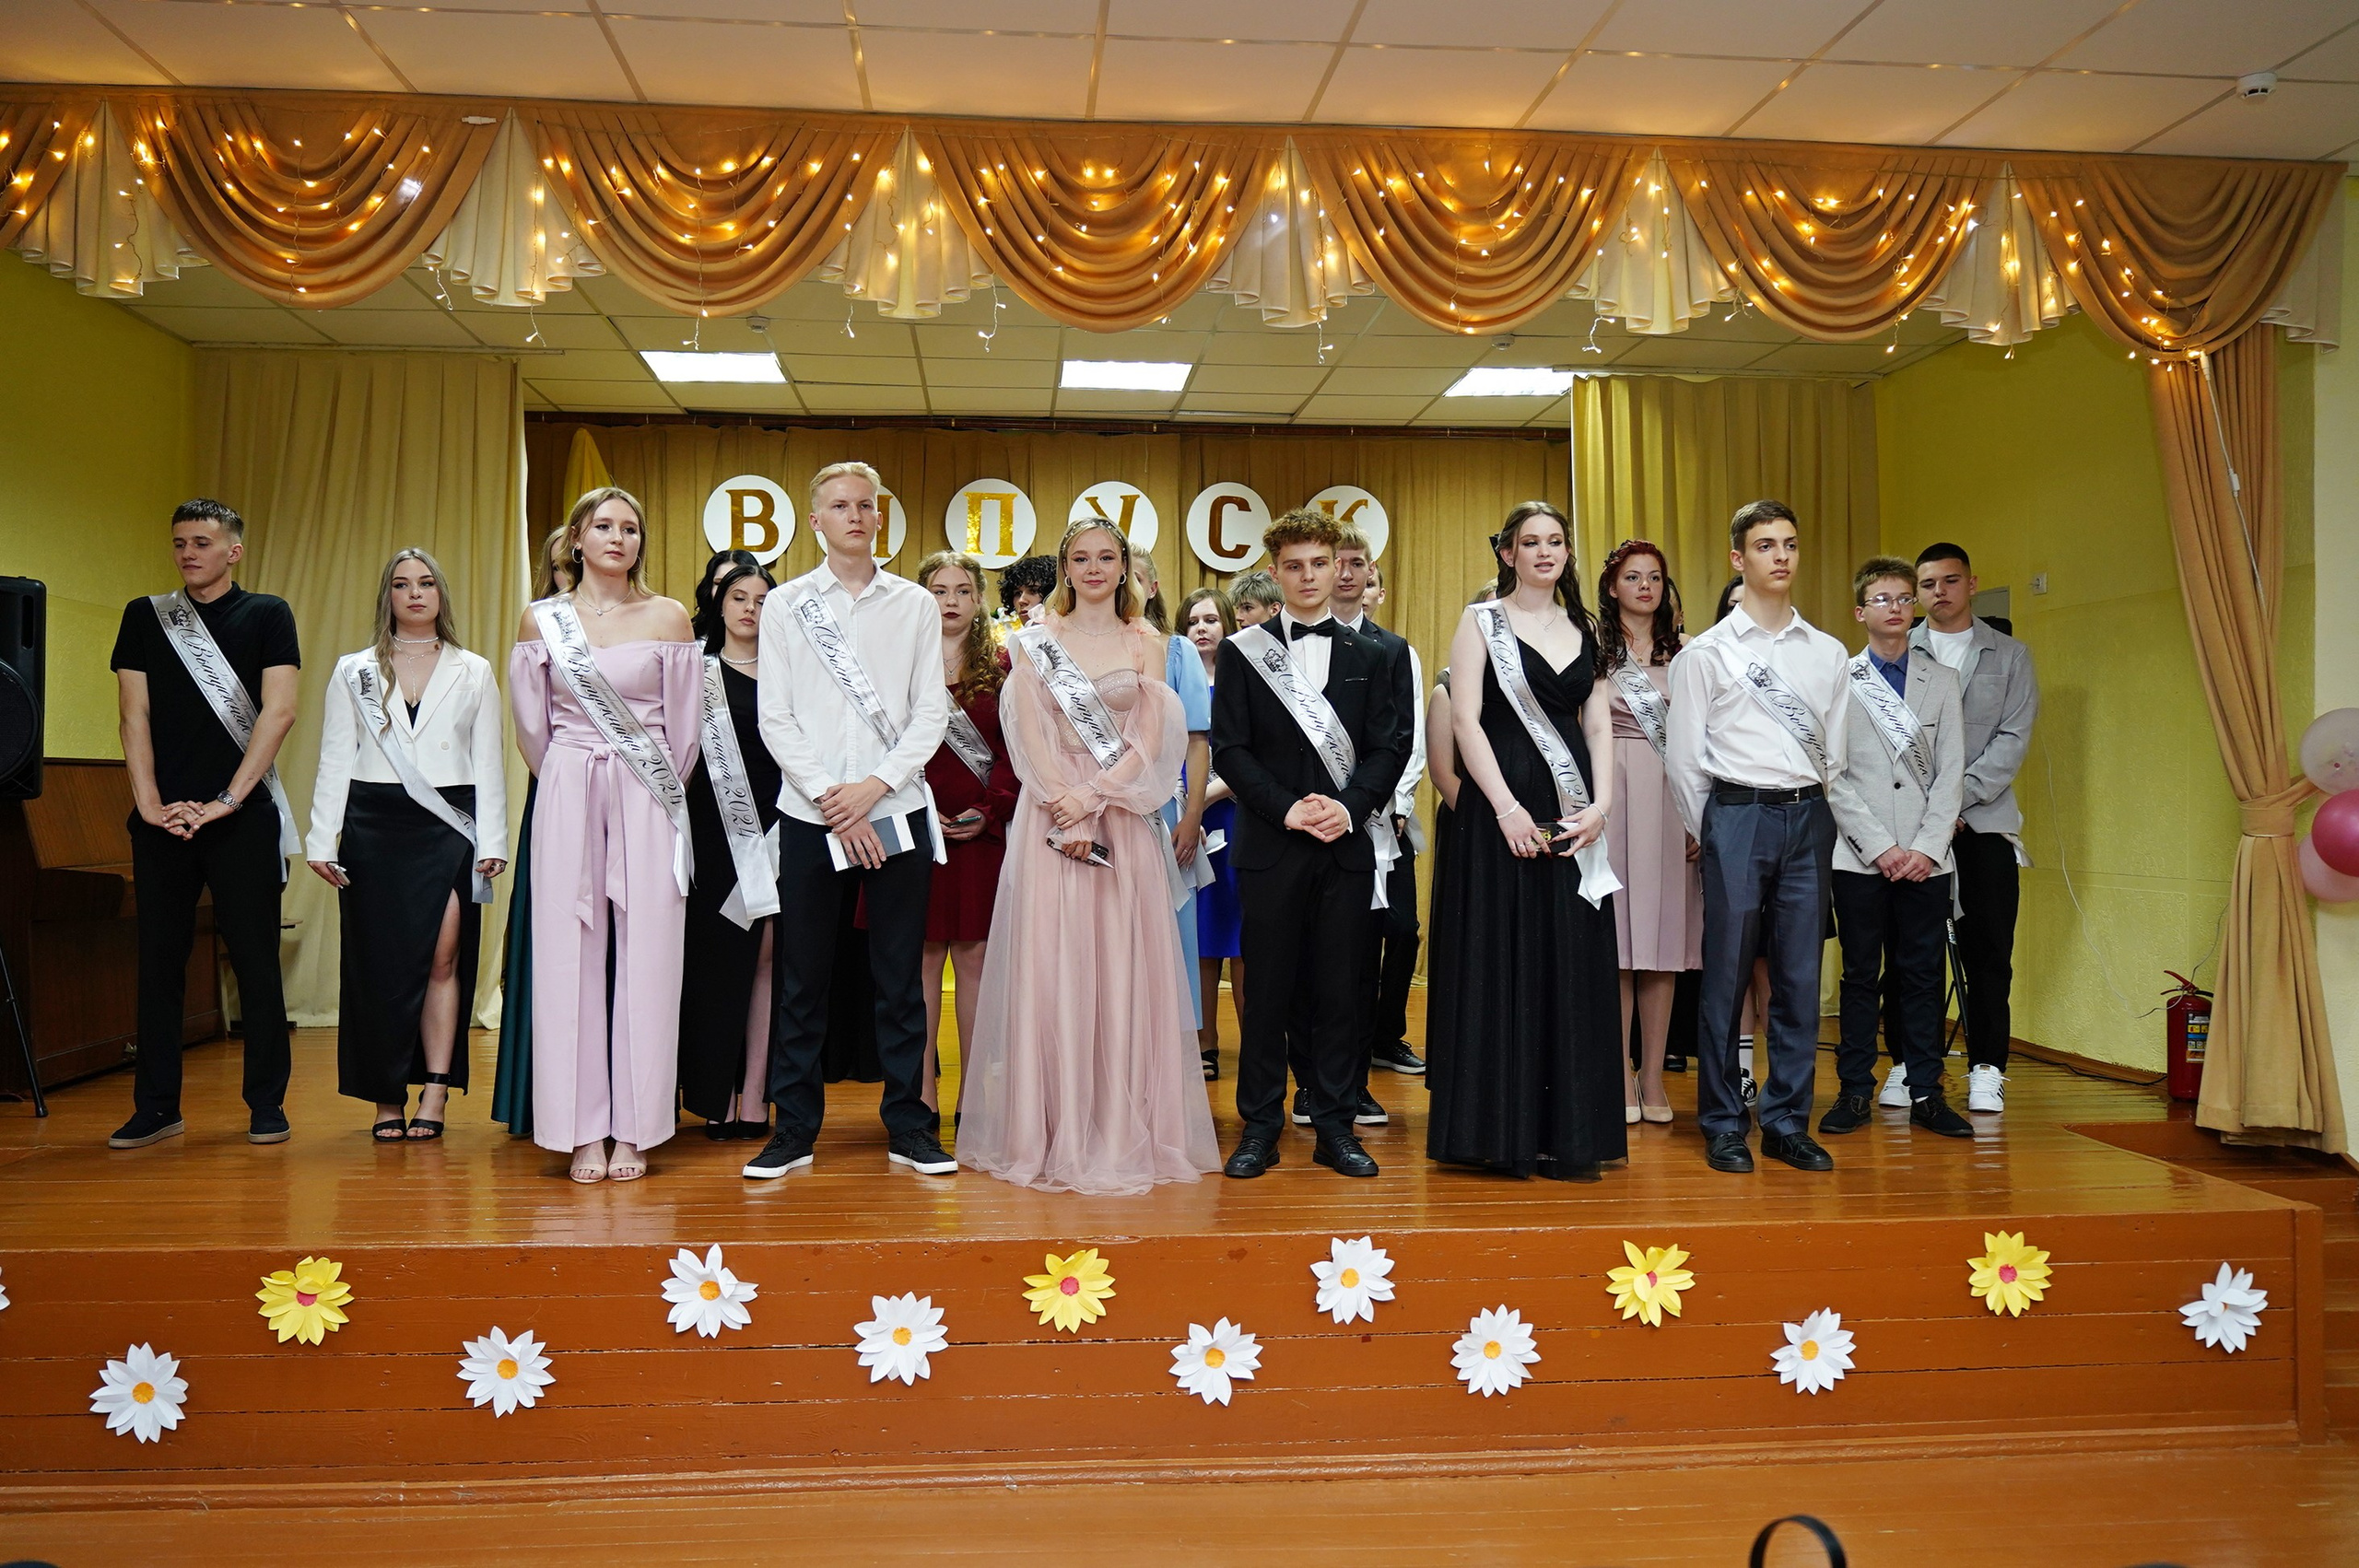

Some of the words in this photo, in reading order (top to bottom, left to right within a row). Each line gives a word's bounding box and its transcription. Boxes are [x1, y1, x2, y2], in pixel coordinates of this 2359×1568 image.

[638, 754, 684, 806] 2024
[1549, 757, 1588, 810] 2024
[723, 787, 757, 839] 2024
